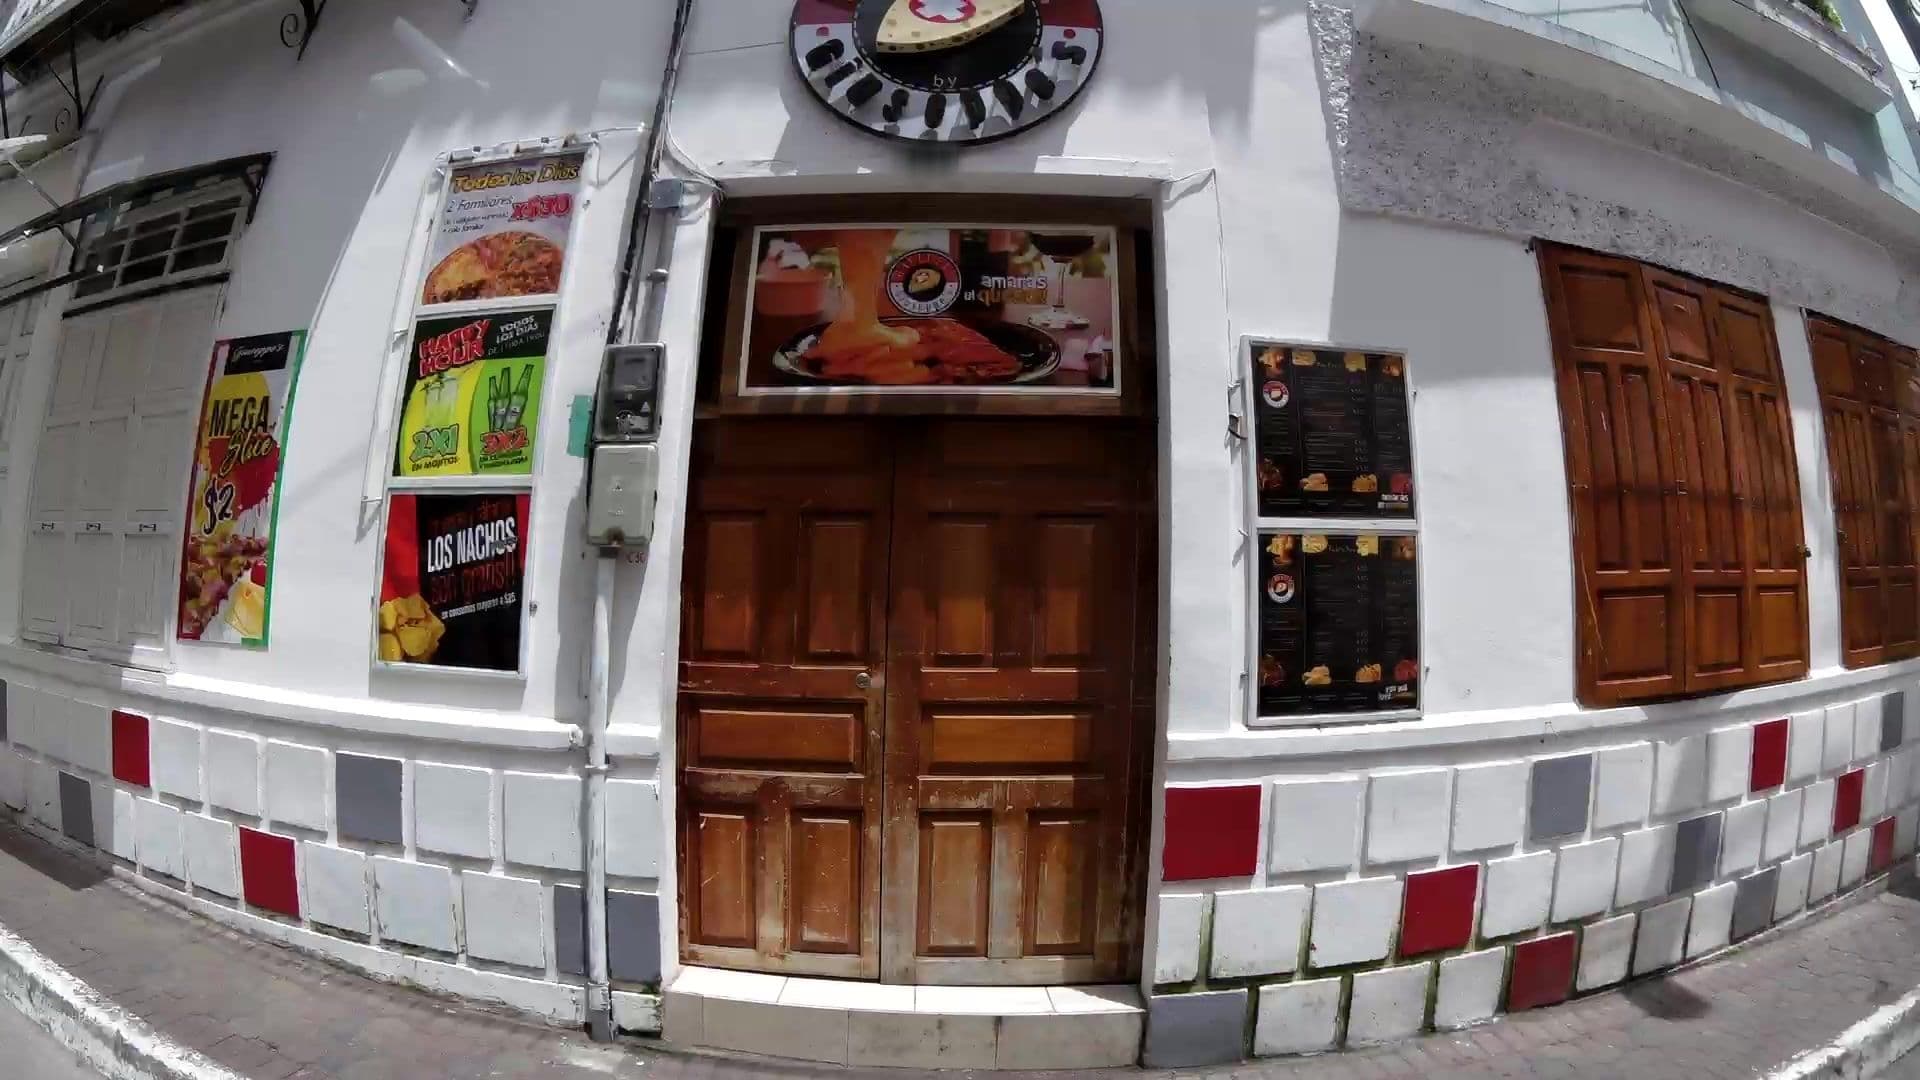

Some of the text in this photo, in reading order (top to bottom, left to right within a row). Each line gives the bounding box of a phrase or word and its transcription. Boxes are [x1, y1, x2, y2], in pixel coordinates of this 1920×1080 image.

[934, 73, 957, 88] by
[453, 173, 509, 193] Todos
[510, 168, 534, 185] los
[419, 319, 492, 359] HAPPY
[419, 342, 486, 378] HOUR
[208, 395, 270, 438] MEGA
[202, 477, 235, 536] $2
[427, 516, 518, 573] LOS NACHOS
